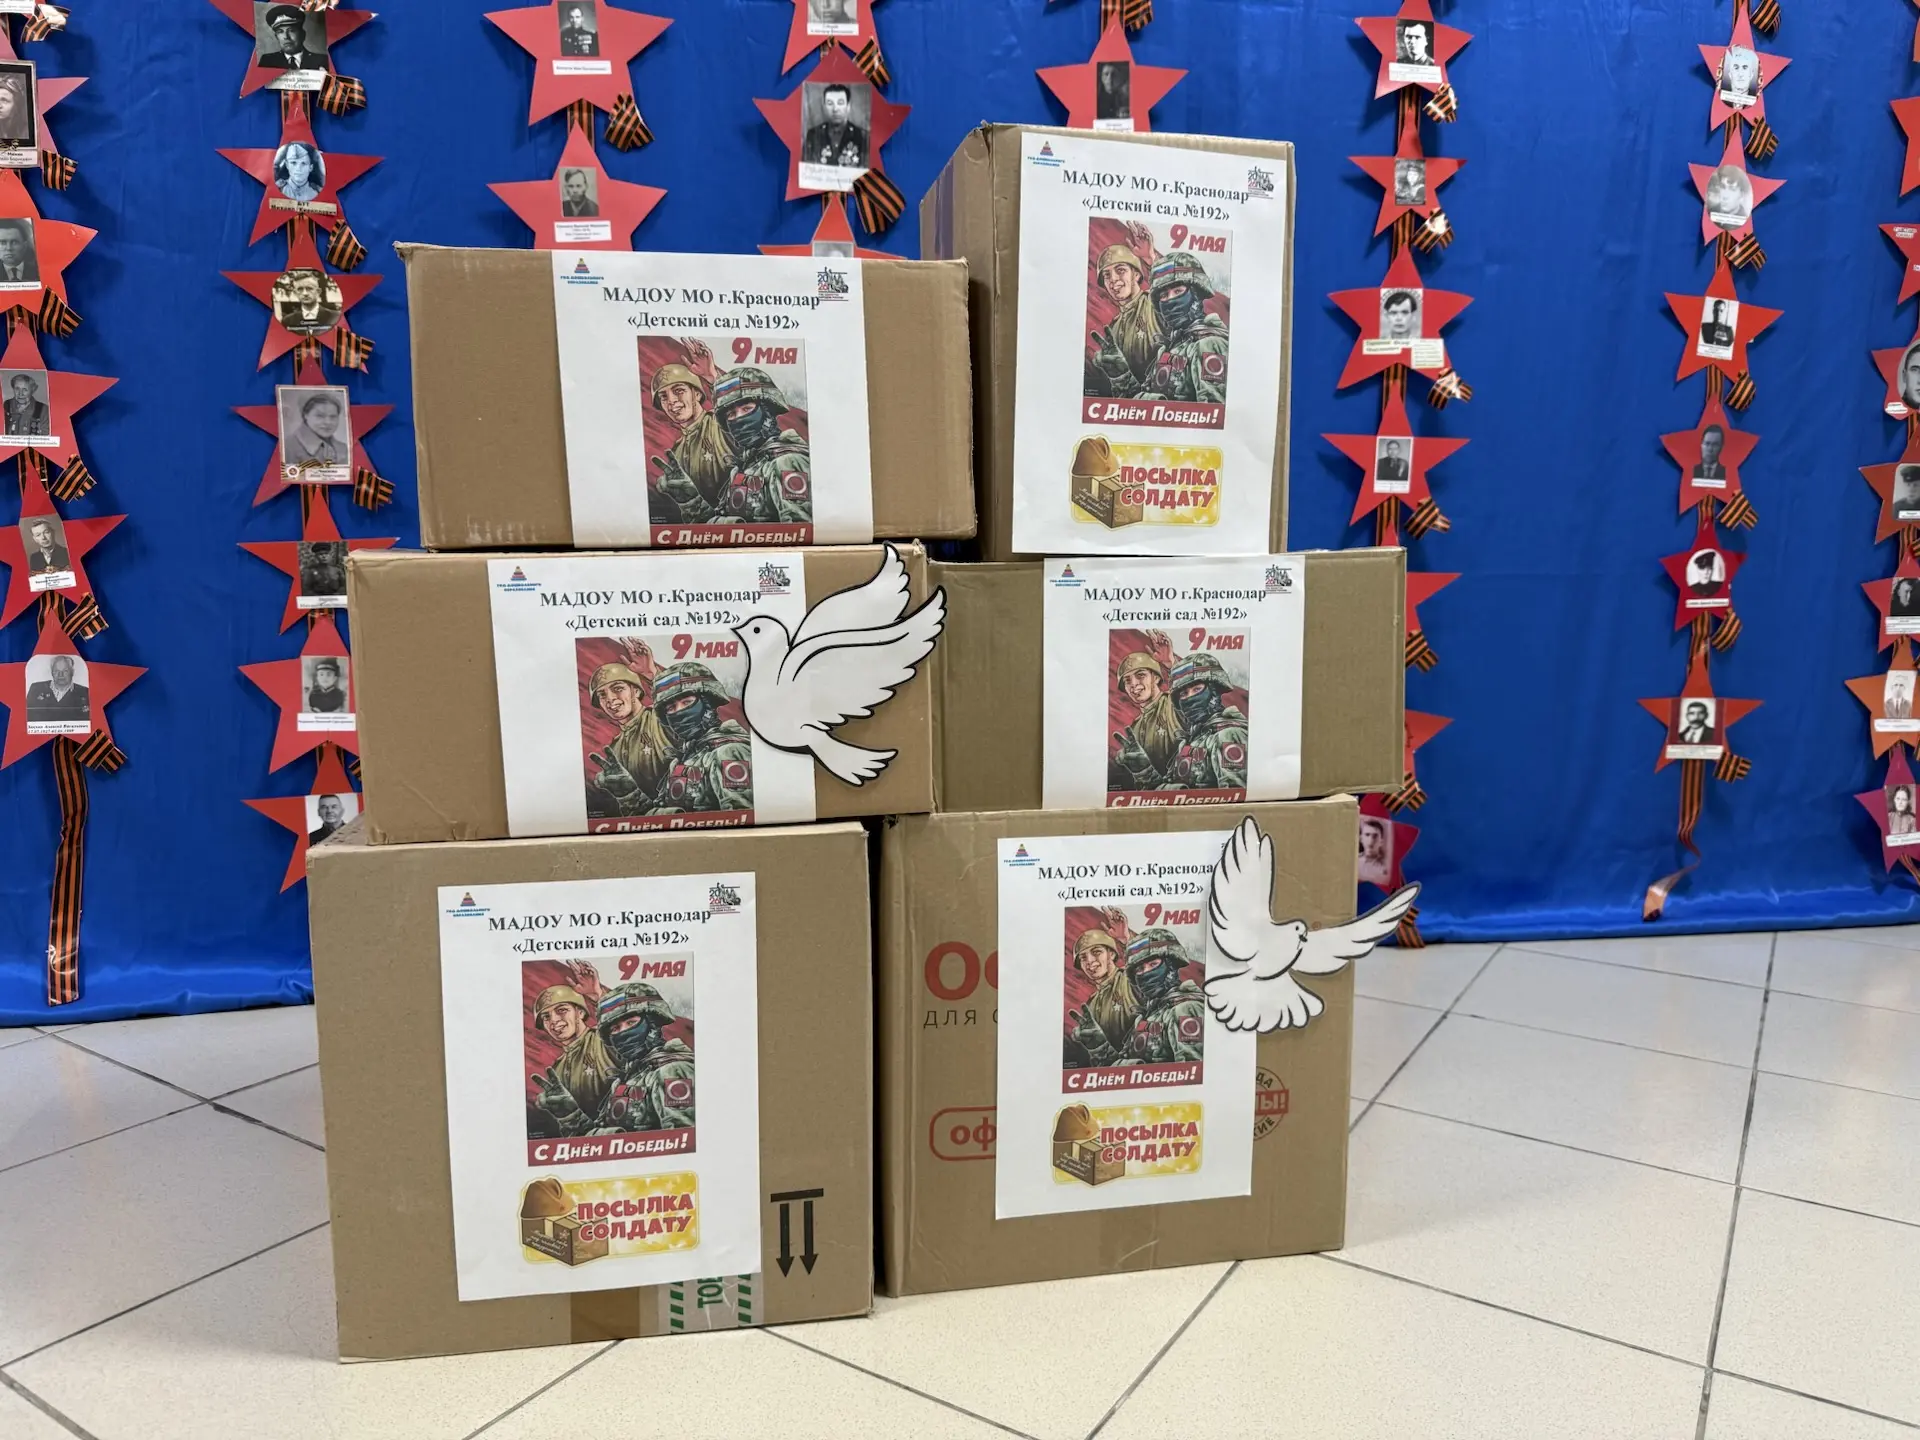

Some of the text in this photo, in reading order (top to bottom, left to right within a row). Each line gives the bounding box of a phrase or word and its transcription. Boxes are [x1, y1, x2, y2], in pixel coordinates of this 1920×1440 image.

[1063, 169, 1249, 204] МАДОУ МО г.Краснодар
[1082, 195, 1230, 221] «Детский сад №192»
[1170, 224, 1227, 253] 9 МАЯ
[602, 286, 820, 310] МАДОУ МО г.Краснодар
[628, 311, 800, 330] «Детский сад №192»
[731, 337, 798, 364] 9 МАЯ
[1087, 403, 1102, 418] С
[1120, 466, 1217, 486] ПОСЫЛКА
[1121, 488, 1215, 509] СОЛДАТУ
[657, 530, 672, 545] С
[540, 591, 614, 607] МАДОУ
[620, 589, 653, 604] МО
[658, 588, 761, 605] г.Краснодар
[1084, 587, 1266, 602] МАДОУ МО г.Краснодар
[565, 611, 740, 630] «Детский сад №192»
[1102, 607, 1247, 623] «Детский сад №192»
[671, 634, 739, 659] 9 МАЯ
[1189, 627, 1244, 650] 9 МАЯ
[1038, 866, 1099, 881] МАДОУ
[1104, 865, 1131, 877] МО
[1057, 882, 1204, 900] «Детский сад №192»
[488, 909, 711, 932] МАДОУ МО г.Краснодар
[1144, 903, 1201, 926] 9 МАЯ
[512, 931, 689, 955] «Детский сад №192»
[618, 955, 686, 980] 9 МАЯ
[924, 1010, 977, 1029] ДЛЯ
[1068, 1073, 1080, 1088] С
[1101, 1122, 1199, 1144] ПОСЫЛКА
[534, 1144, 549, 1161] С
[1101, 1142, 1197, 1164] СОЛДАТУ
[577, 1193, 694, 1221] ПОСЫЛКА
[579, 1216, 692, 1241] СОЛДАТУ
